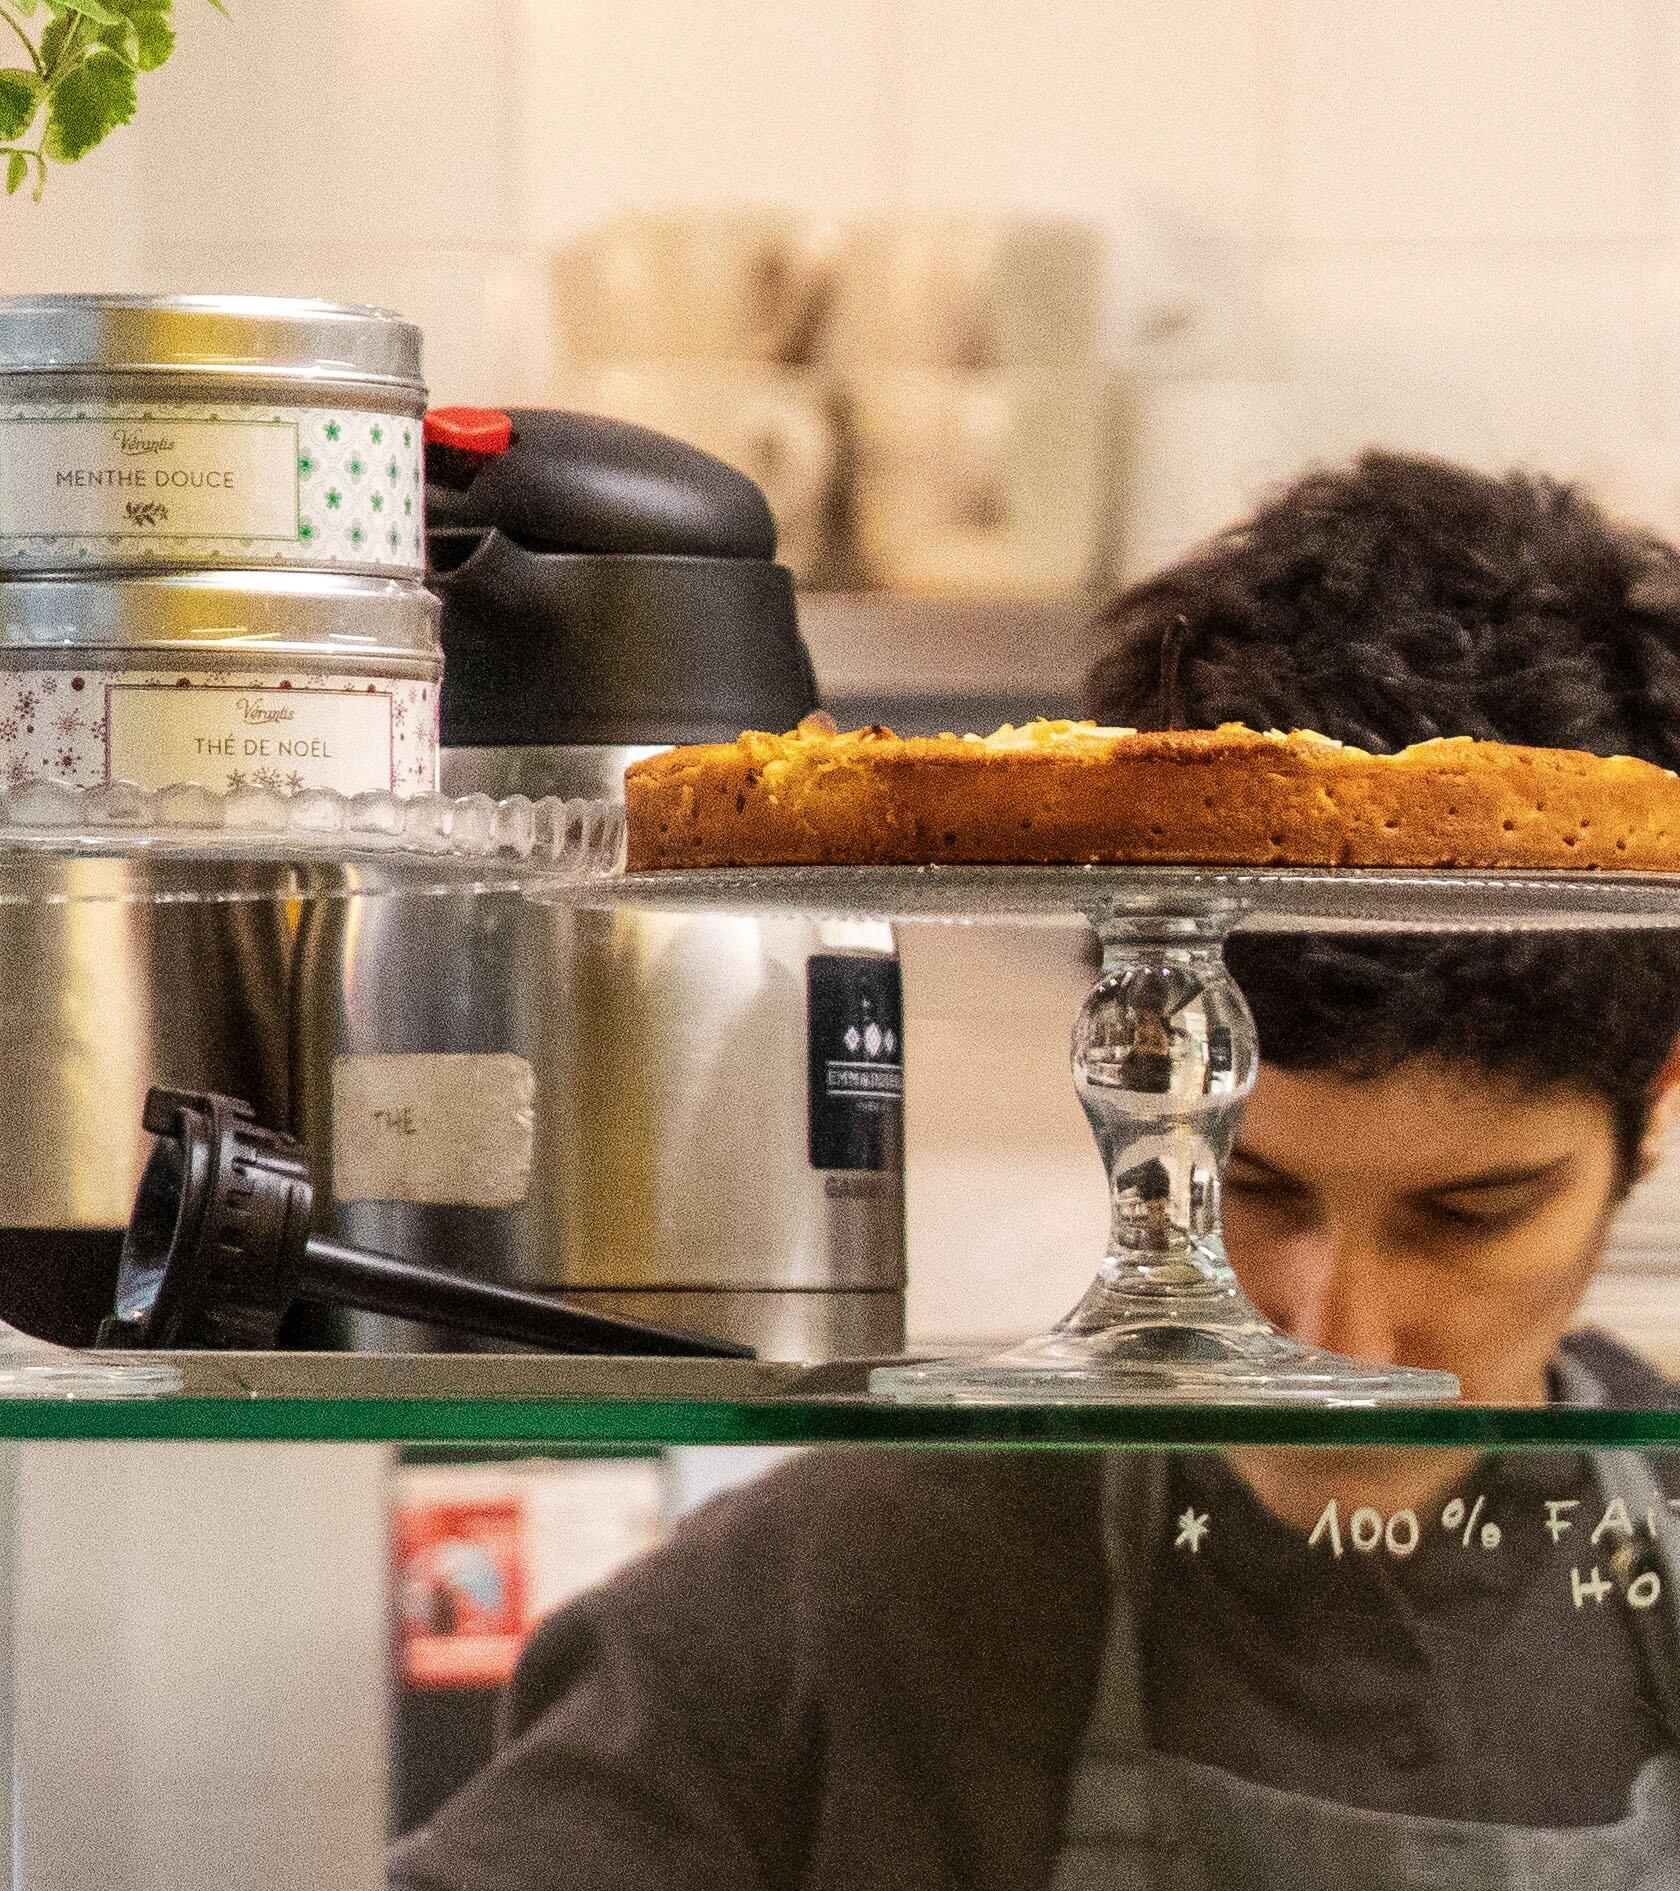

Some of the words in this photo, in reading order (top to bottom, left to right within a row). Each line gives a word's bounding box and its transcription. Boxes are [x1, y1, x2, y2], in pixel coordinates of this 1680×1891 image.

[56, 469, 146, 488] MENTHE
[156, 471, 234, 489] DOUCE
[194, 736, 234, 756] THÉ
[244, 738, 270, 756] DE
[279, 738, 332, 759] NOËL
